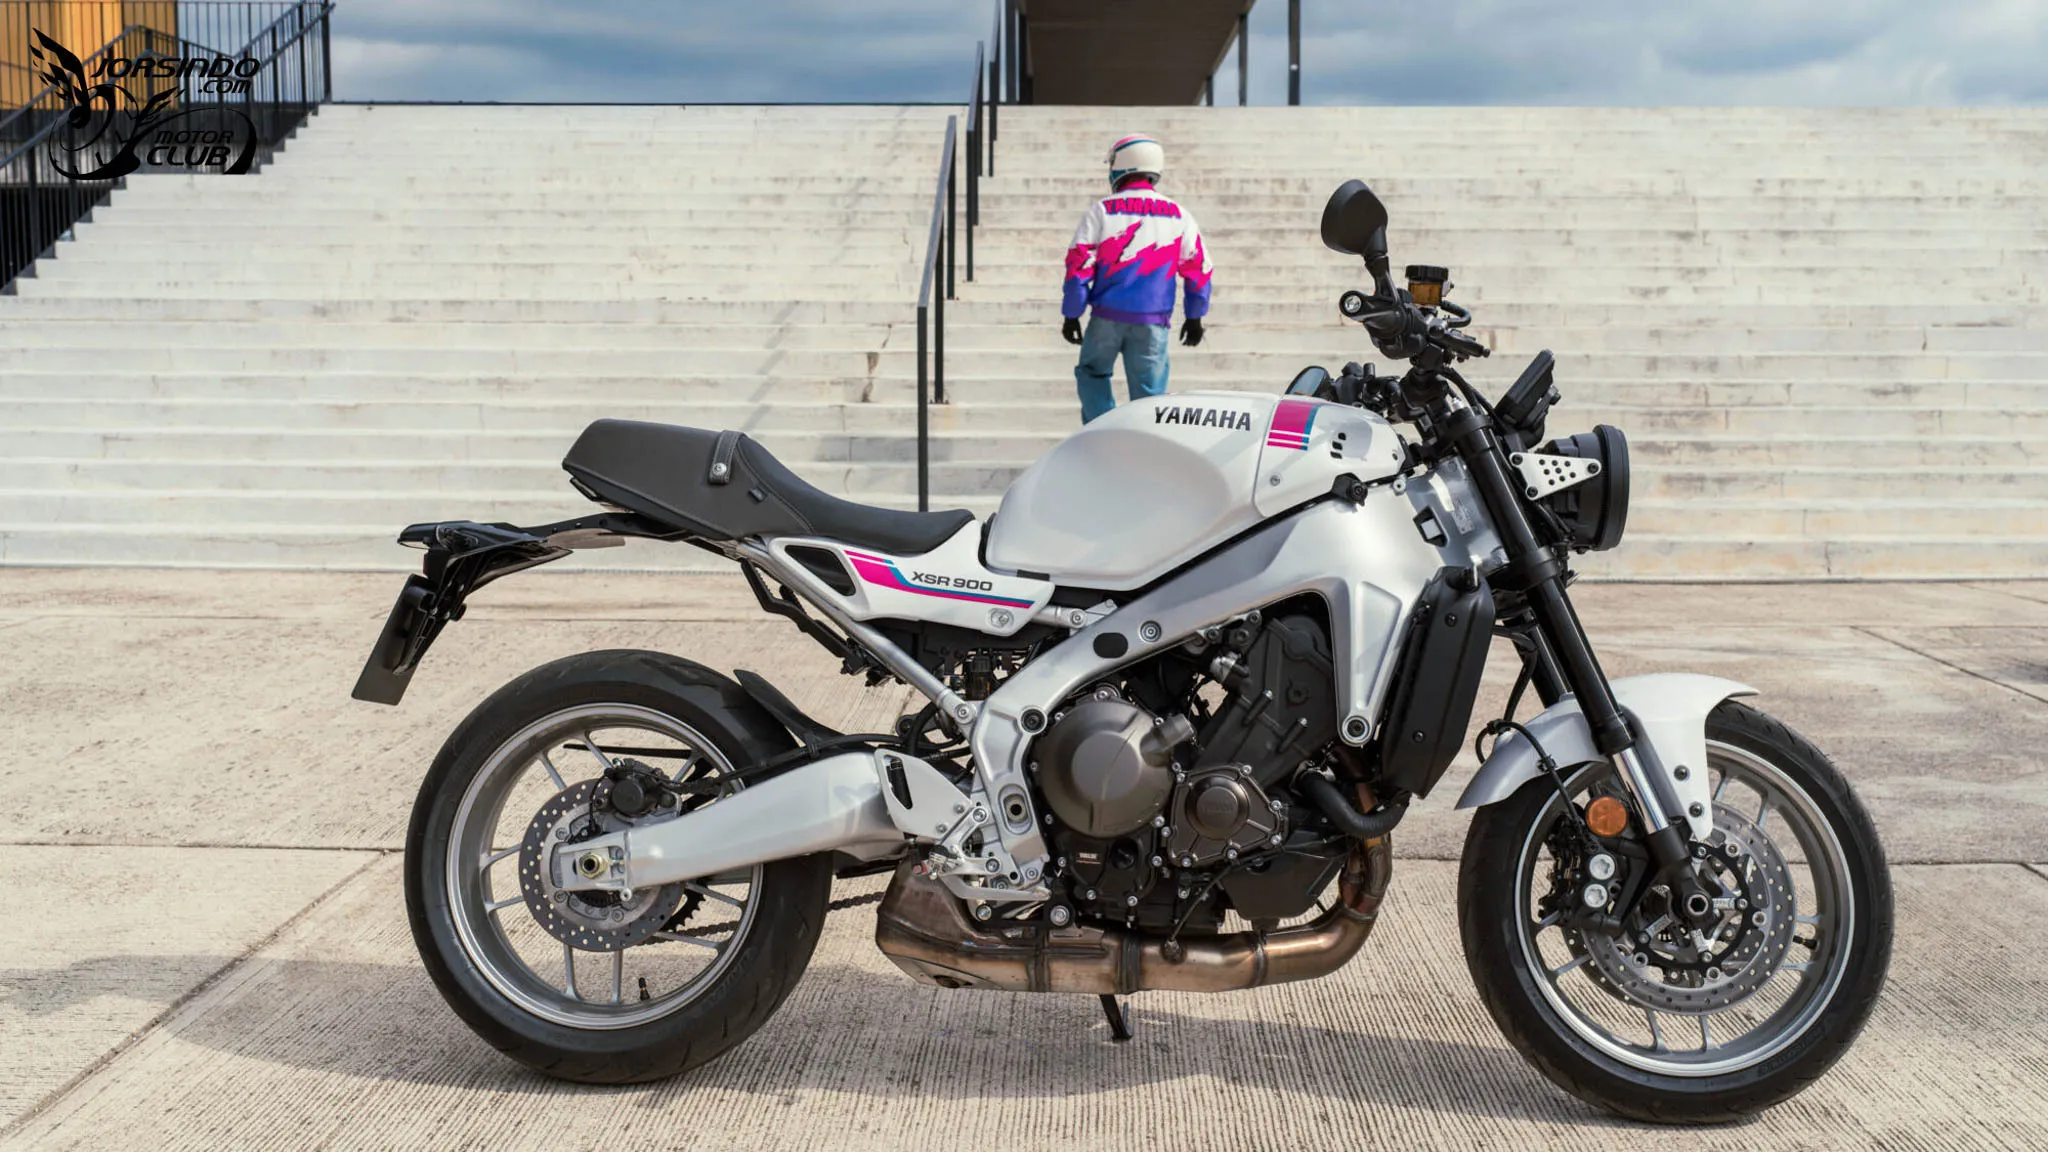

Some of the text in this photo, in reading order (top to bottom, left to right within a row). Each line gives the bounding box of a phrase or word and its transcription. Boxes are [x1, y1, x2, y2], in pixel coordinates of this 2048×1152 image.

[1102, 197, 1182, 219] YAMAHA
[1154, 406, 1250, 430] YAMAHA
[912, 571, 992, 591] XSR 900
